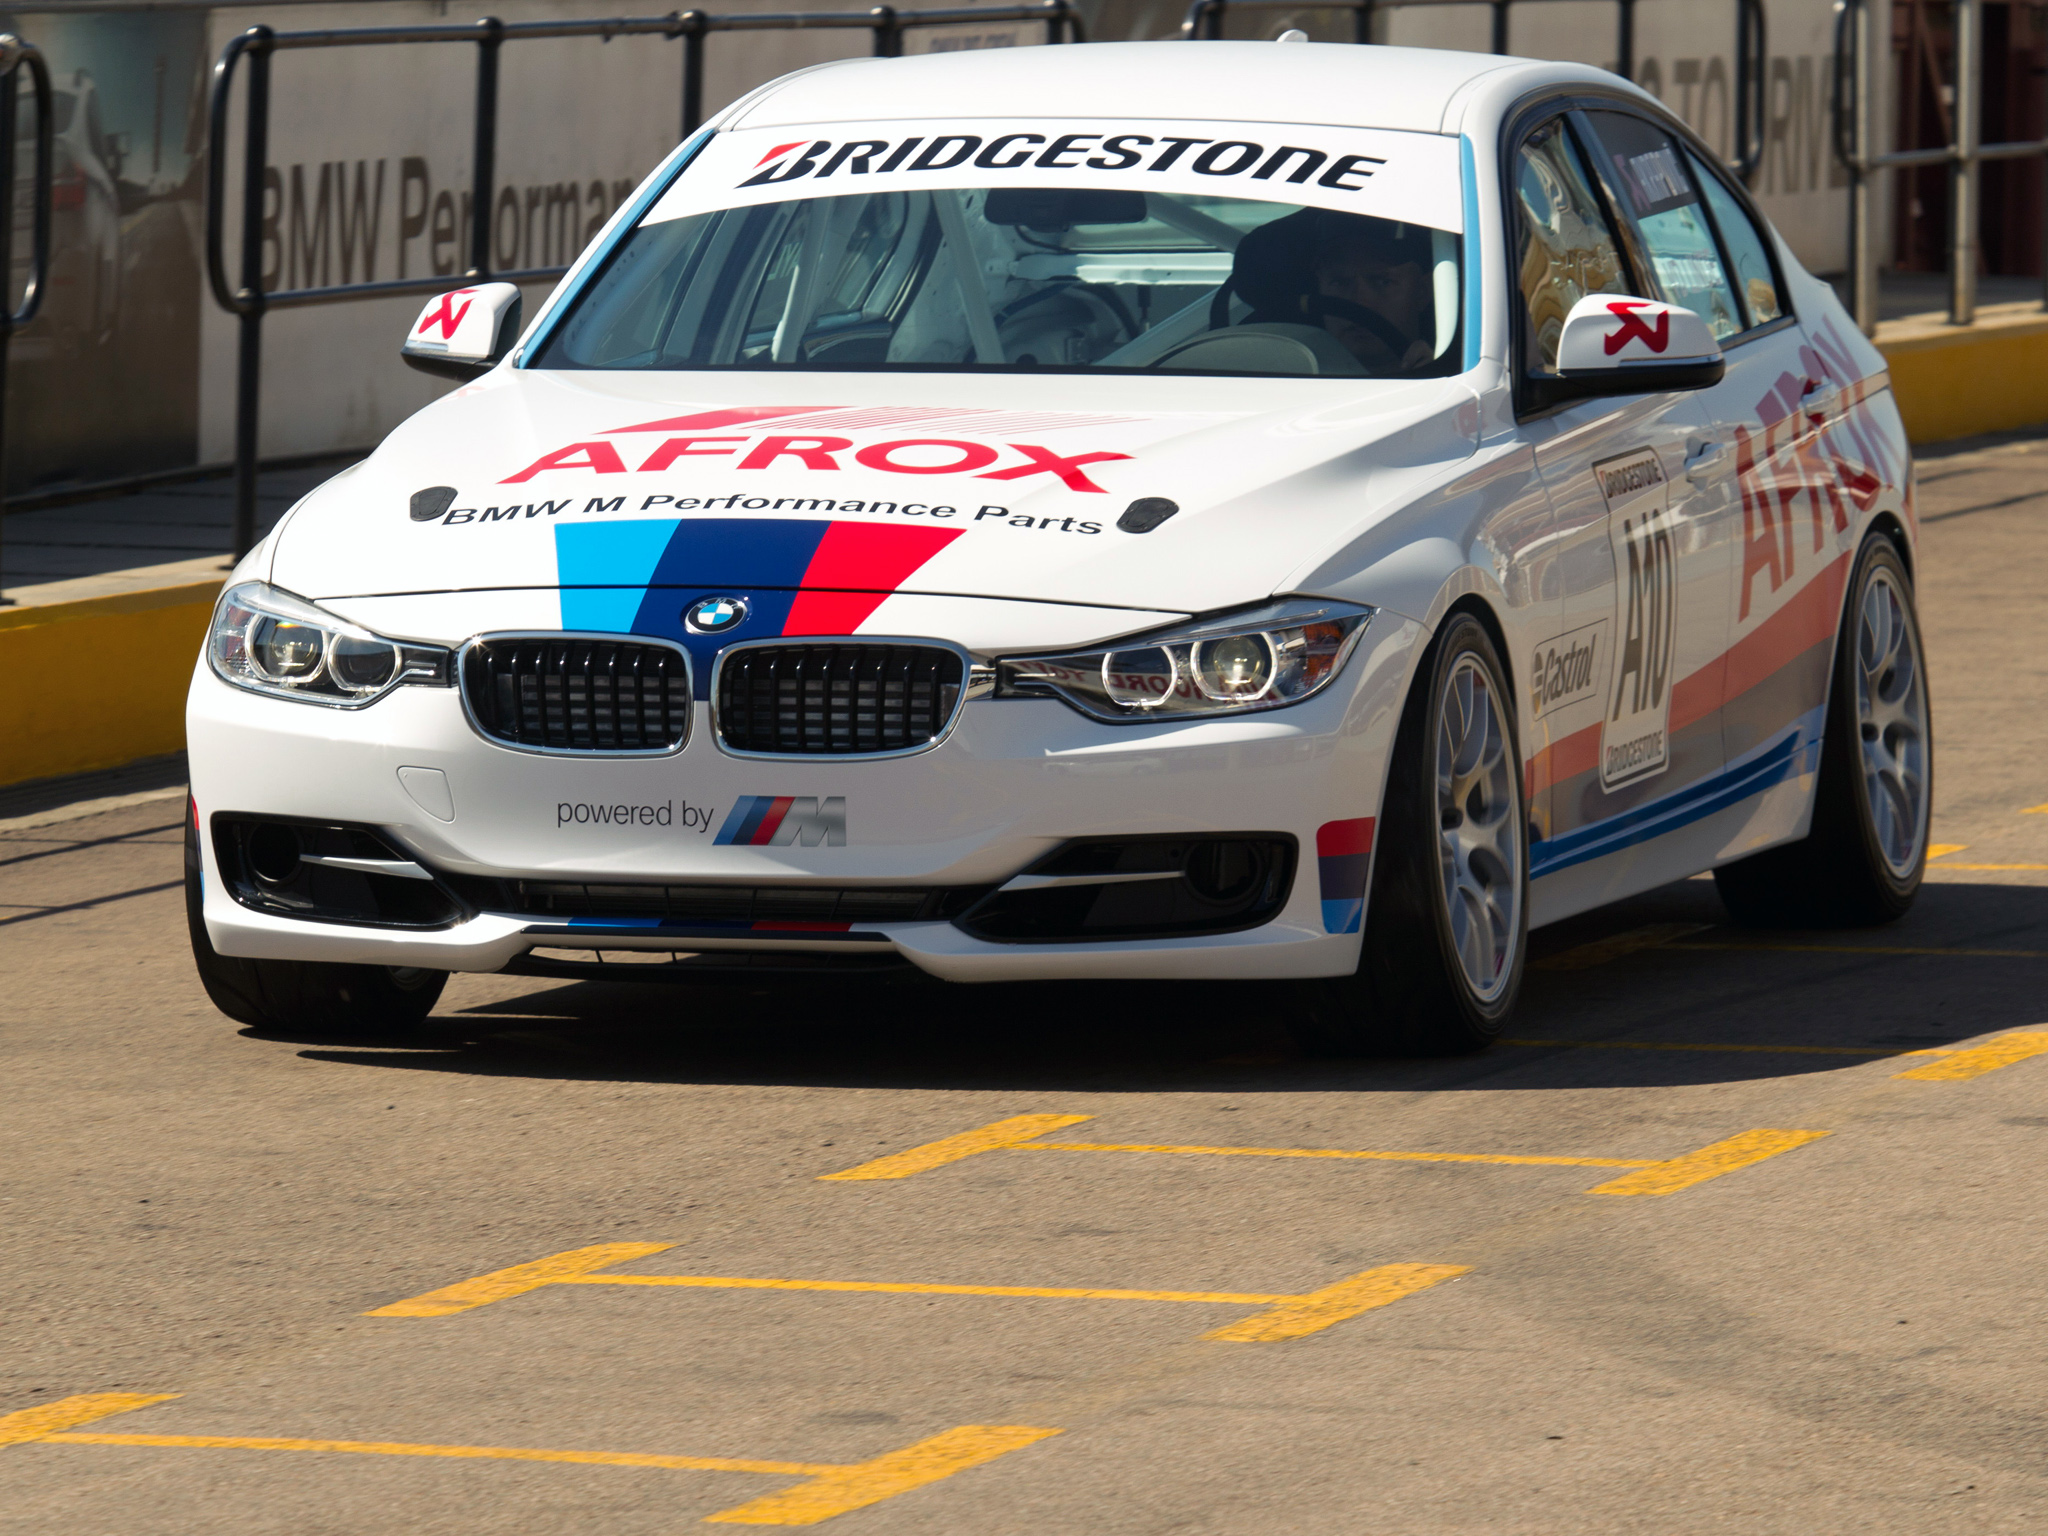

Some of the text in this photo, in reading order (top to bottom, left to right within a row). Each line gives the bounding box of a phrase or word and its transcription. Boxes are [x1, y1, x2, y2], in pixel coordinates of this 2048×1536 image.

[734, 134, 1388, 190] BRIDGESTONE
[263, 158, 386, 294] BMW
[495, 436, 1137, 494] AFROX
[1600, 458, 1662, 499] BRIDGESTONE
[1733, 313, 1906, 625] AFROX
[442, 493, 1104, 535] BMW M Performance Parts
[1541, 633, 1597, 702] Castrol
[1606, 730, 1663, 777] BRIDGESTONE
[557, 796, 847, 848] powered by M
